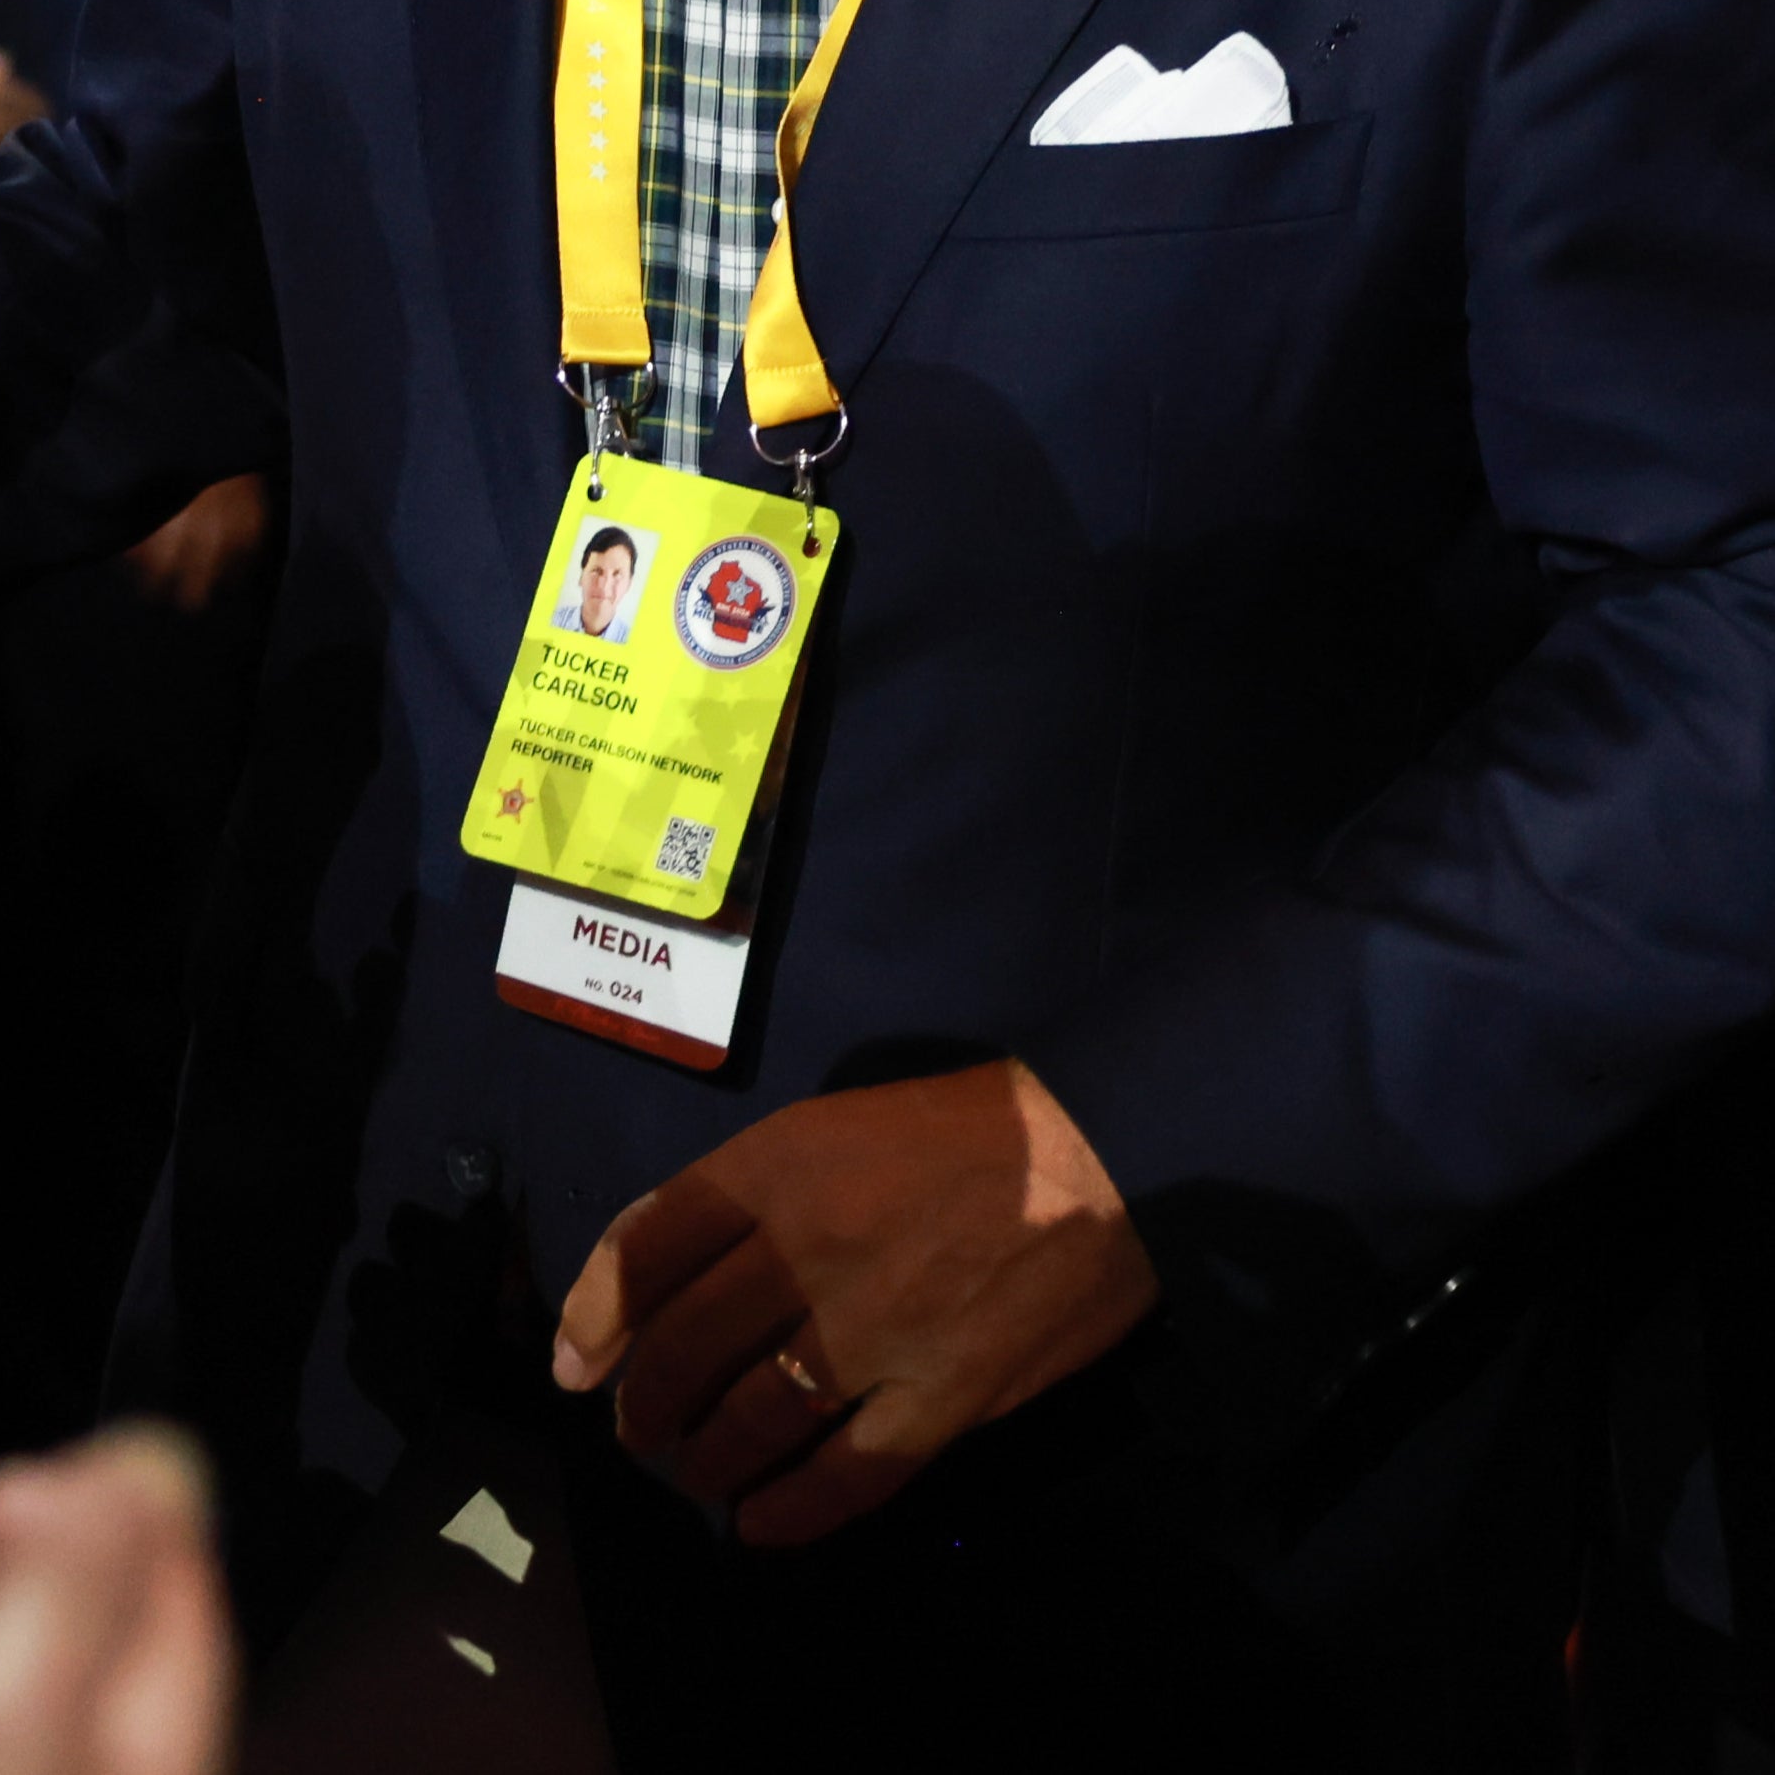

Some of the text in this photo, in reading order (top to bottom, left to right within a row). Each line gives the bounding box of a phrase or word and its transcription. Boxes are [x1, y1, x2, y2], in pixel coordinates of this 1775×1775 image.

[543, 644, 629, 684] TUCKER
[533, 671, 638, 715] CARLSON
[511, 740, 593, 773] REPORTER
[519, 718, 723, 784] TUCKER CARLSON NETWORK
[573, 915, 672, 971] MEDIA
[609, 981, 643, 1005] 024
